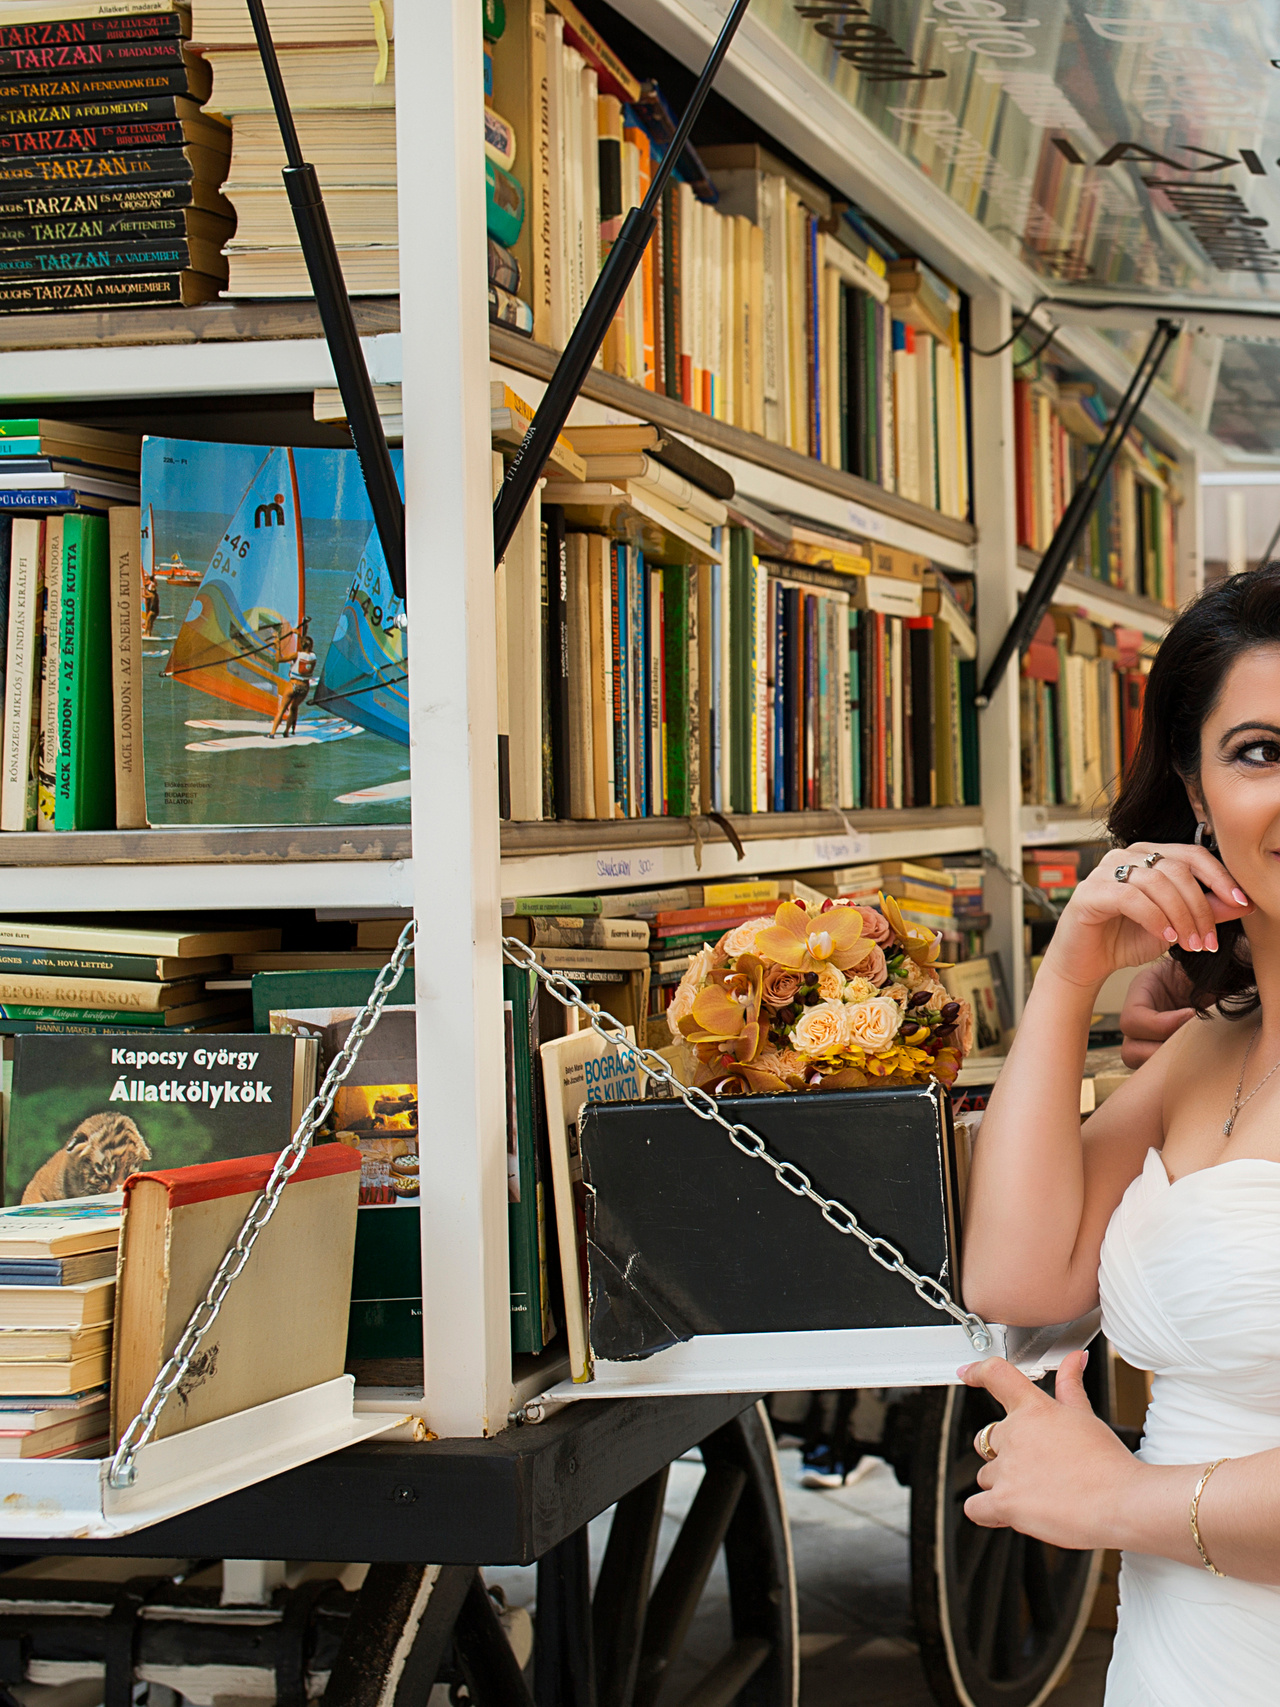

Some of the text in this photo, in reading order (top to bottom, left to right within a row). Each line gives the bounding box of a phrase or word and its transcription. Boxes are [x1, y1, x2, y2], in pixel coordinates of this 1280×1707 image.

[99, 3, 162, 14] Állatkerti madarak
[0, 22, 86, 47] TARZAN
[107, 20, 120, 30] AZ
[121, 16, 170, 28] ELVESZETT
[106, 28, 160, 40] BIRODALOM
[11, 45, 102, 69] TARZAN
[106, 50, 114, 58] A
[119, 46, 176, 58] DIADALMAS
[20, 81, 80, 97] TARZAN
[82, 84, 90, 92] A
[91, 79, 144, 91] FENEVADAK
[146, 77, 169, 87] ÉLÉN
[6, 106, 71, 124] TARZAN
[75, 108, 82, 117] A
[84, 105, 108, 116] FÖLD
[110, 102, 148, 115] MÉLYÉN
[10, 128, 97, 151] TARZAN
[116, 126, 128, 134] AZ
[130, 122, 176, 133] ELVESZETT
[116, 133, 166, 145] BIRODALOM
[0, 156, 152, 180] OUGHS TARZAN FIA
[23, 194, 98, 215] TARZAN
[100, 194, 110, 202] ÉS
[112, 193, 123, 202] AZ
[125, 188, 175, 201] ARANYSZŐRŰ
[120, 198, 161, 210] OROSZLÁN
[31, 220, 103, 241] TARZAN
[109, 224, 117, 232] A
[120, 220, 176, 232] RETTENETES
[0, 251, 179, 271] ROUGHS TARZAN A VADEMBER
[0, 282, 171, 300] OUGHS TARZAN A MAJOMEMBER
[506, 464, 517, 482] 171
[514, 449, 525, 466] 827
[0, 494, 57, 504] ÜLŐGÉPEN
[49, 535, 60, 586] VÁNDORA
[559, 539, 568, 602] SOPRON
[48, 590, 58, 638] FÉLHOLD
[10, 558, 27, 783] RÓNASZEGI MIKLÓS AZ INDIÁN KIRÁLYFI
[60, 543, 77, 799] JACK LONDON AZ ÉNEKLŐ KUTYA
[118, 552, 133, 772] JACK LONDON: AZ ÉNEKLŐ KUTYA
[48, 658, 57, 696] VIKTOR
[46, 700, 56, 763] SZOMBATHY
[32, 958, 56, 967] ANYA,
[58, 959, 79, 967] HOVÁ
[81, 960, 114, 970] LETTÉL?
[3, 985, 50, 1000] EFOE:
[36, 1024, 64, 1032] HANNU
[111, 1048, 260, 1070] Kapocsy György
[584, 1050, 636, 1085] BOGRÁCS
[109, 1075, 273, 1108] Állatkölykök
[604, 1076, 639, 1100] KUKTA
